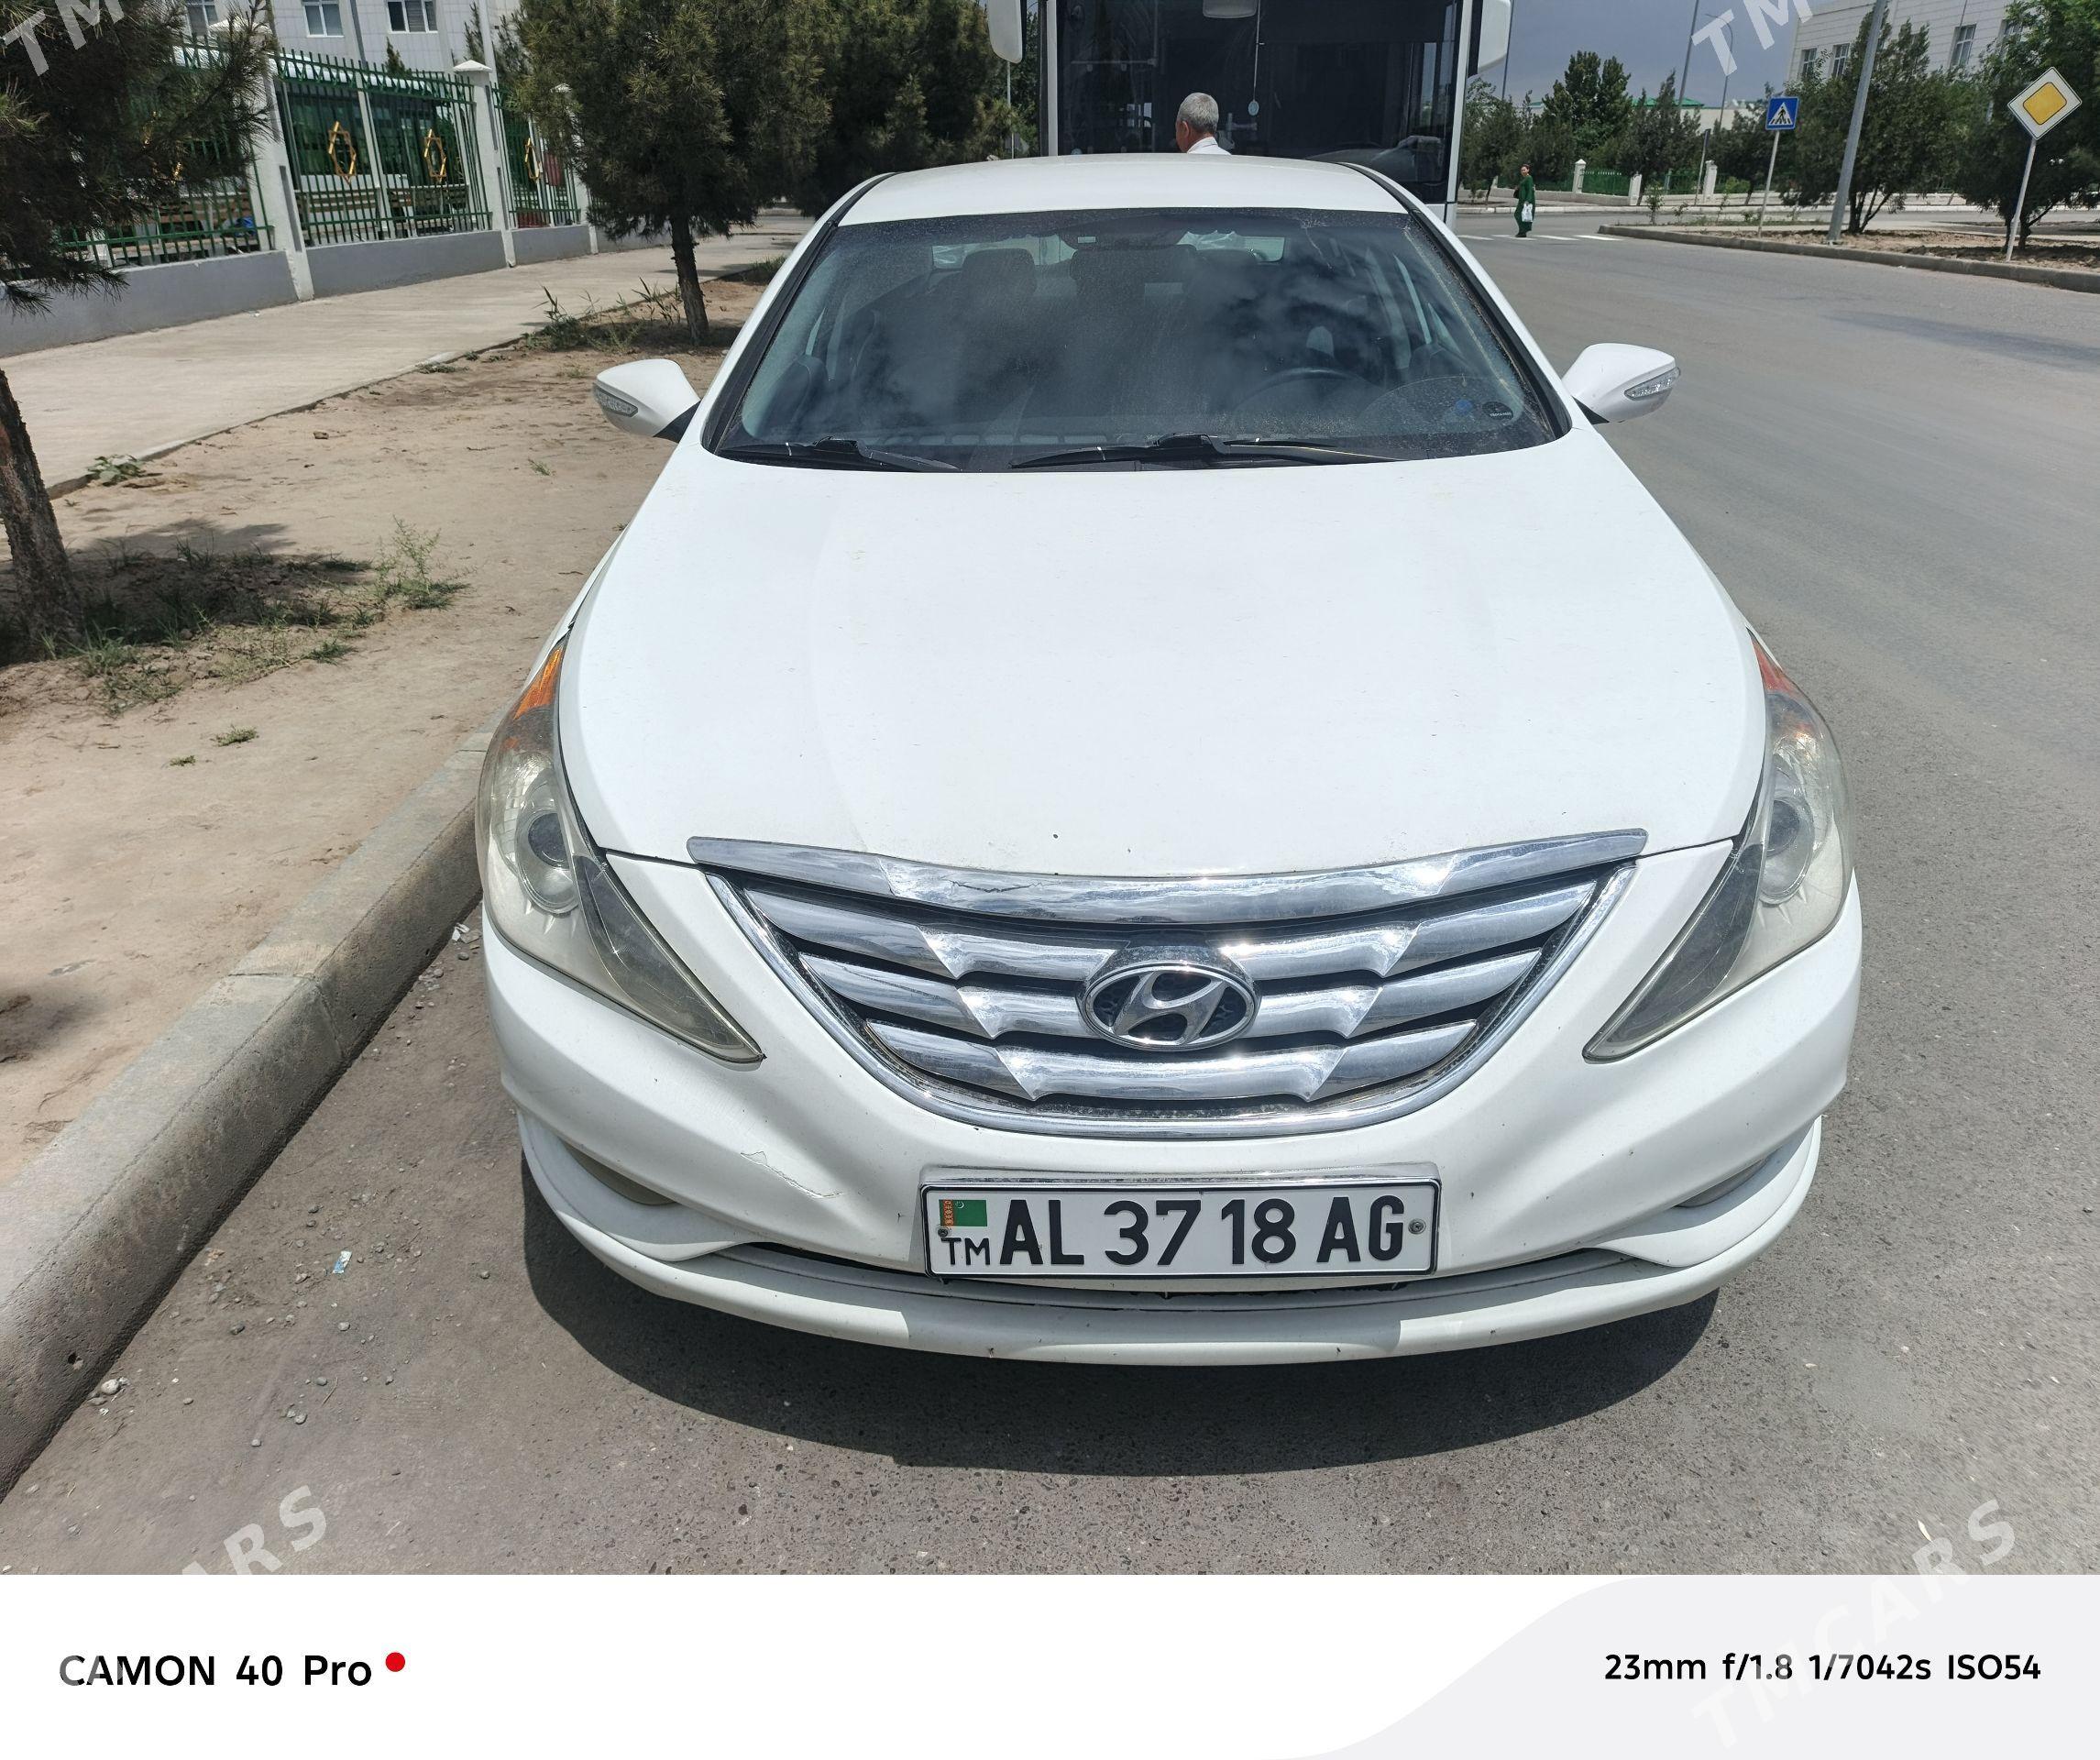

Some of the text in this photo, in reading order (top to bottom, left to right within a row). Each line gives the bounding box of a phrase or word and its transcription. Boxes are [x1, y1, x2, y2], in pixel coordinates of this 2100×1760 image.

[943, 1195, 1405, 1266] TM AL 37 18 AG
